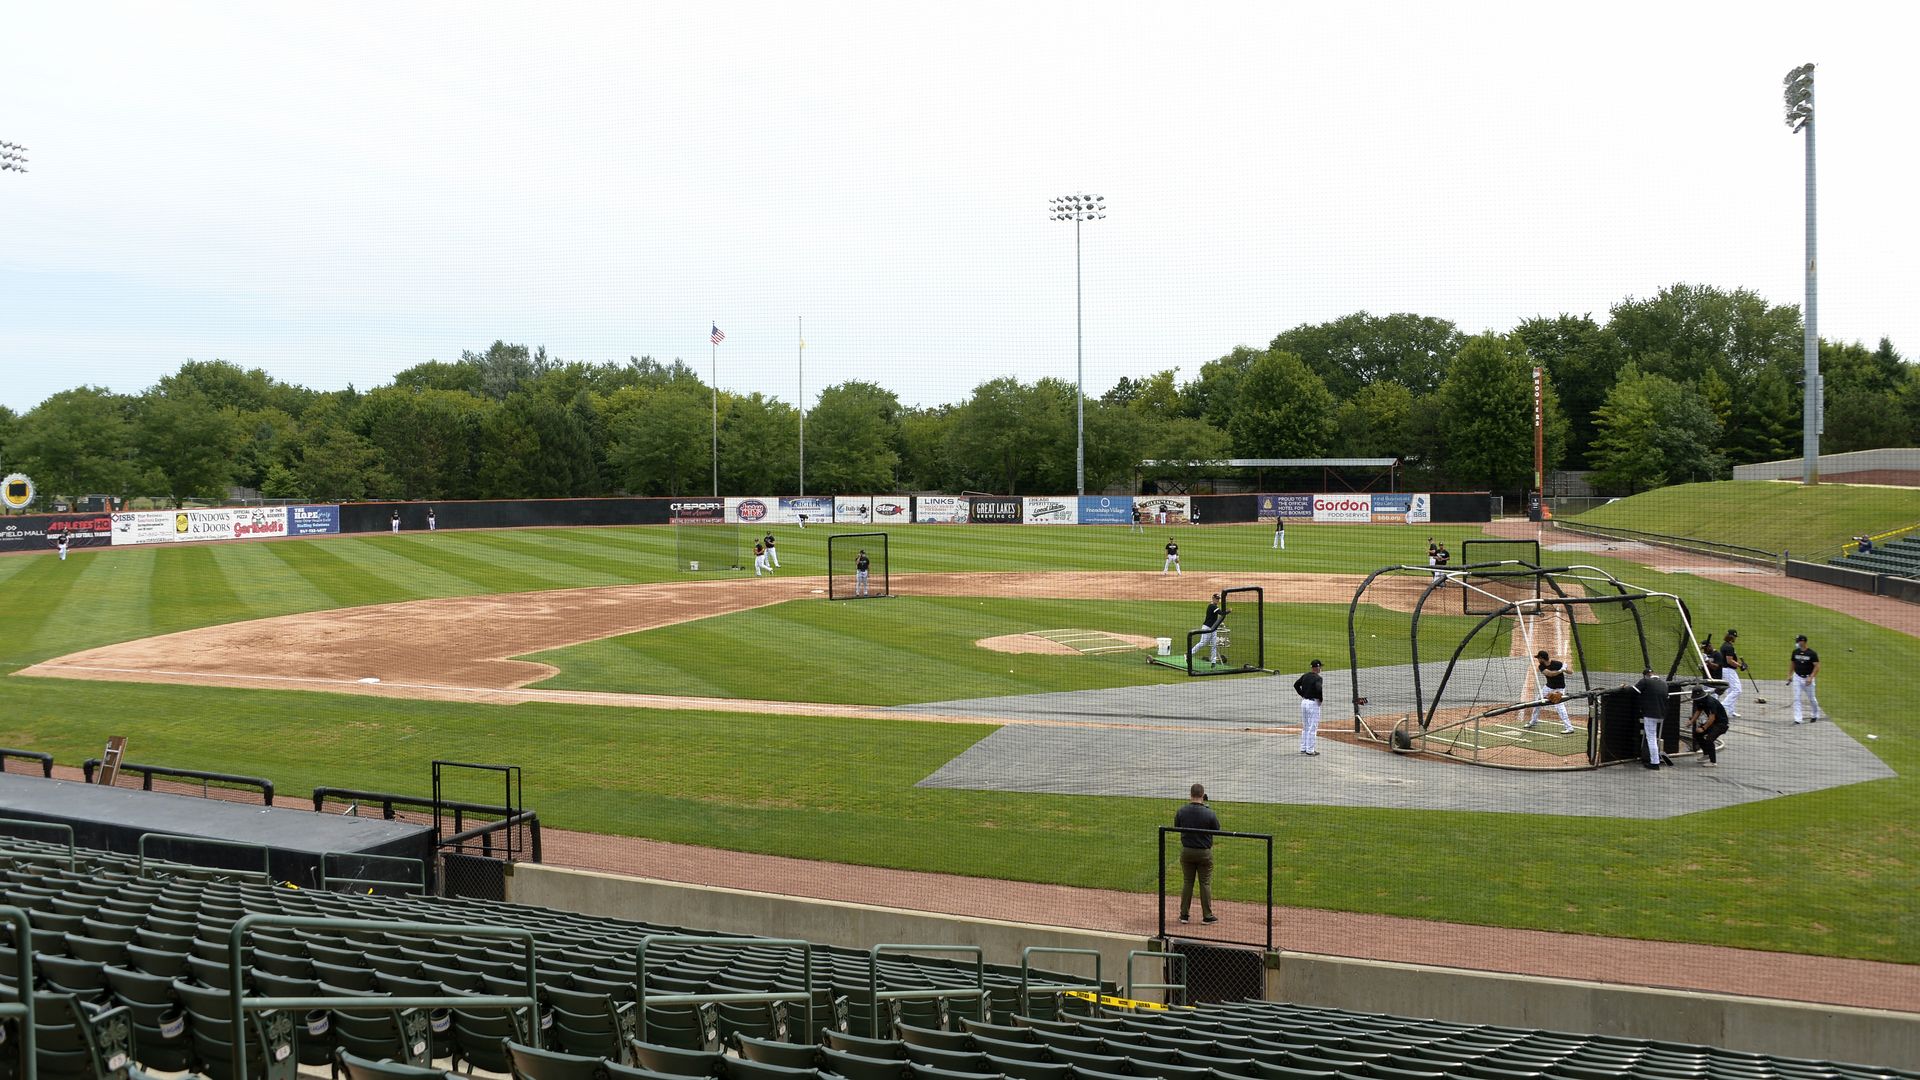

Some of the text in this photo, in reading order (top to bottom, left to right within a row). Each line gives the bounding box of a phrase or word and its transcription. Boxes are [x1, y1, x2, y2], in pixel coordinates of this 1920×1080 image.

[976, 503, 1015, 514] GREAT LAKES
[1314, 499, 1369, 511] Gordon
[189, 512, 230, 521] WINDOWS
[95, 519, 110, 530] HQ
[192, 523, 230, 533] & DOORS
